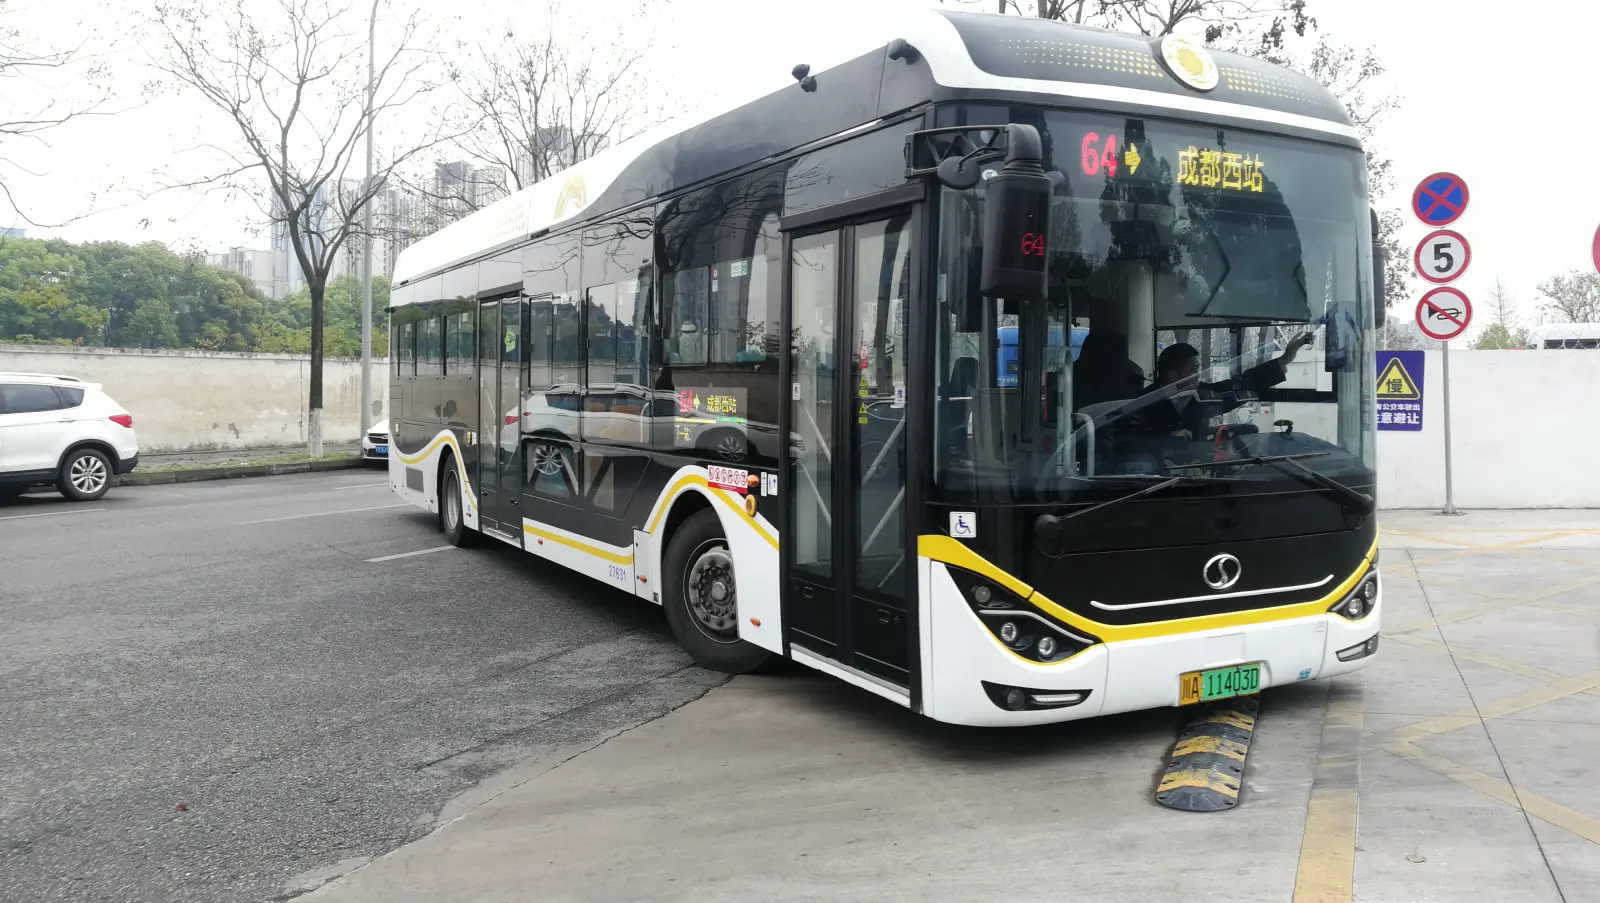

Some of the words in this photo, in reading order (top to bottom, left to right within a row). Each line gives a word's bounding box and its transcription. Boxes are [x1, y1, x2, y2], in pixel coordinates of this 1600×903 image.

[1081, 131, 1118, 178] 64
[1177, 146, 1265, 193] 成都西站
[1021, 232, 1045, 256] 64
[1433, 243, 1453, 273] 5
[1385, 378, 1403, 393] 慢
[679, 390, 693, 414] 64
[707, 395, 737, 413] 成都西站
[1376, 412, 1420, 424] 意避让
[609, 565, 626, 582] 27631
[1182, 676, 1199, 700] 川A
[1207, 667, 1259, 696] 11403D
